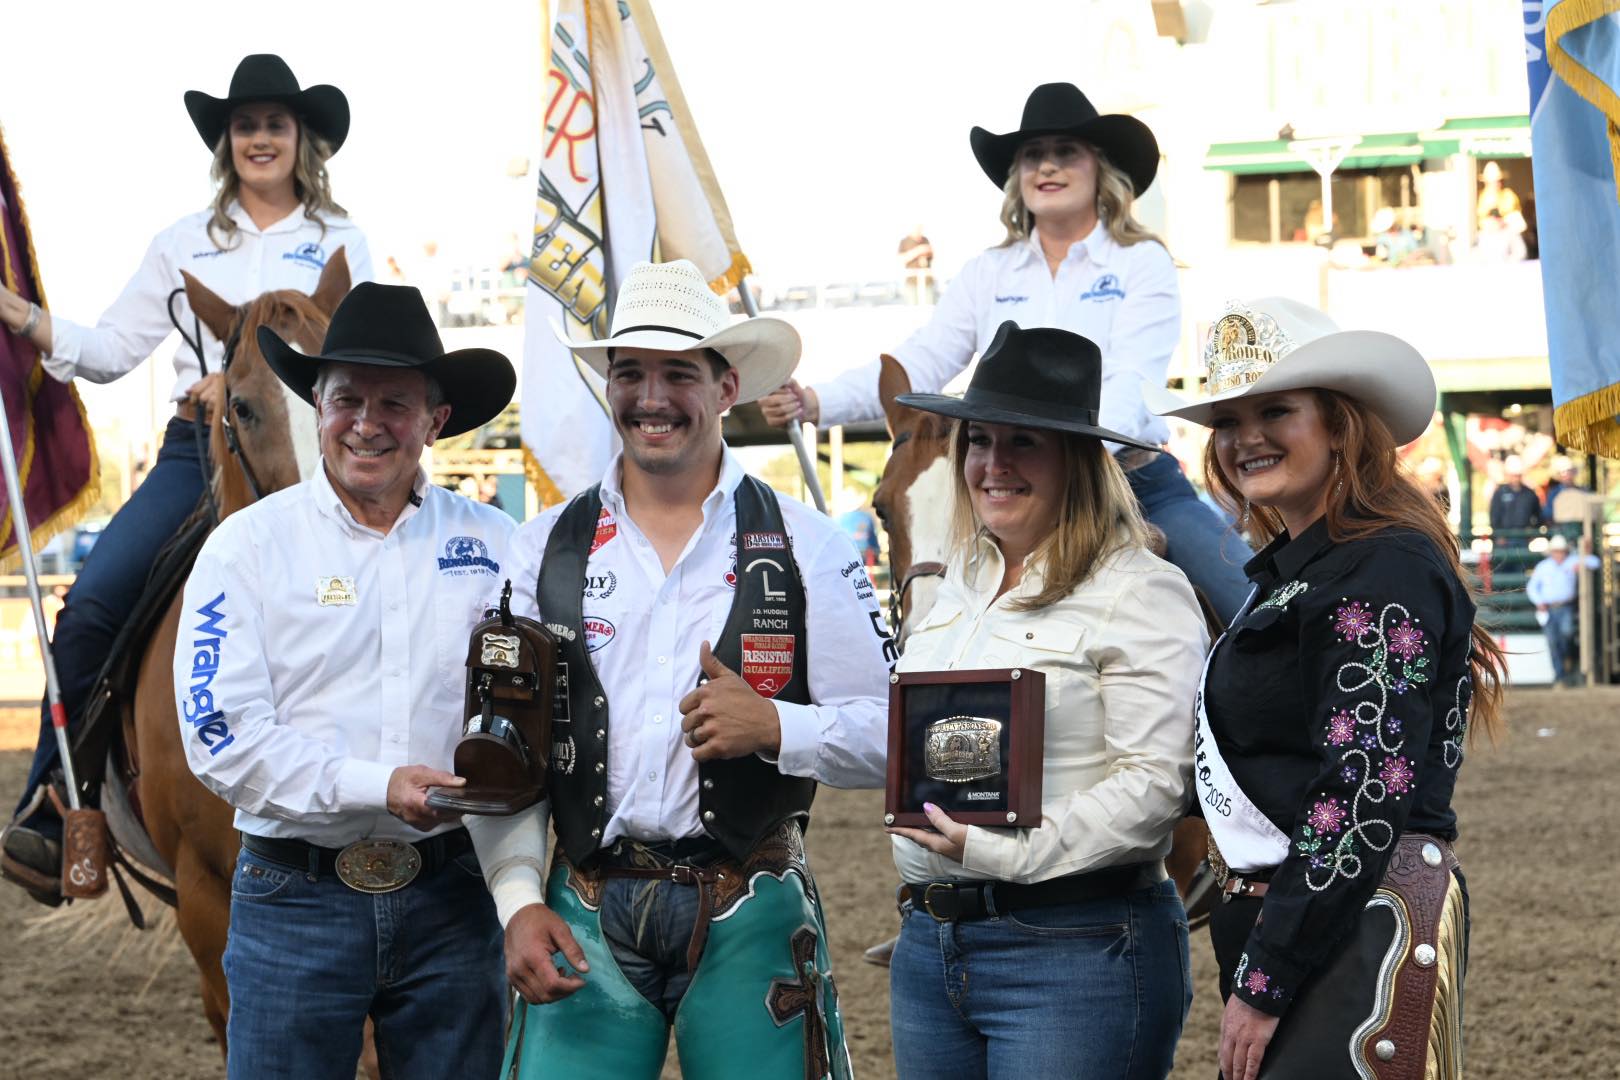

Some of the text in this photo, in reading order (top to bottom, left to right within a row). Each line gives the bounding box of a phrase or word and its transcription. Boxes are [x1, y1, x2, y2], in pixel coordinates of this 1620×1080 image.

[753, 619, 788, 629] RANCH
[743, 650, 792, 663] RESISTOL
[183, 591, 236, 757] Wrangler
[743, 665, 791, 674] QUALIFIER
[1205, 786, 1232, 817] 2025
